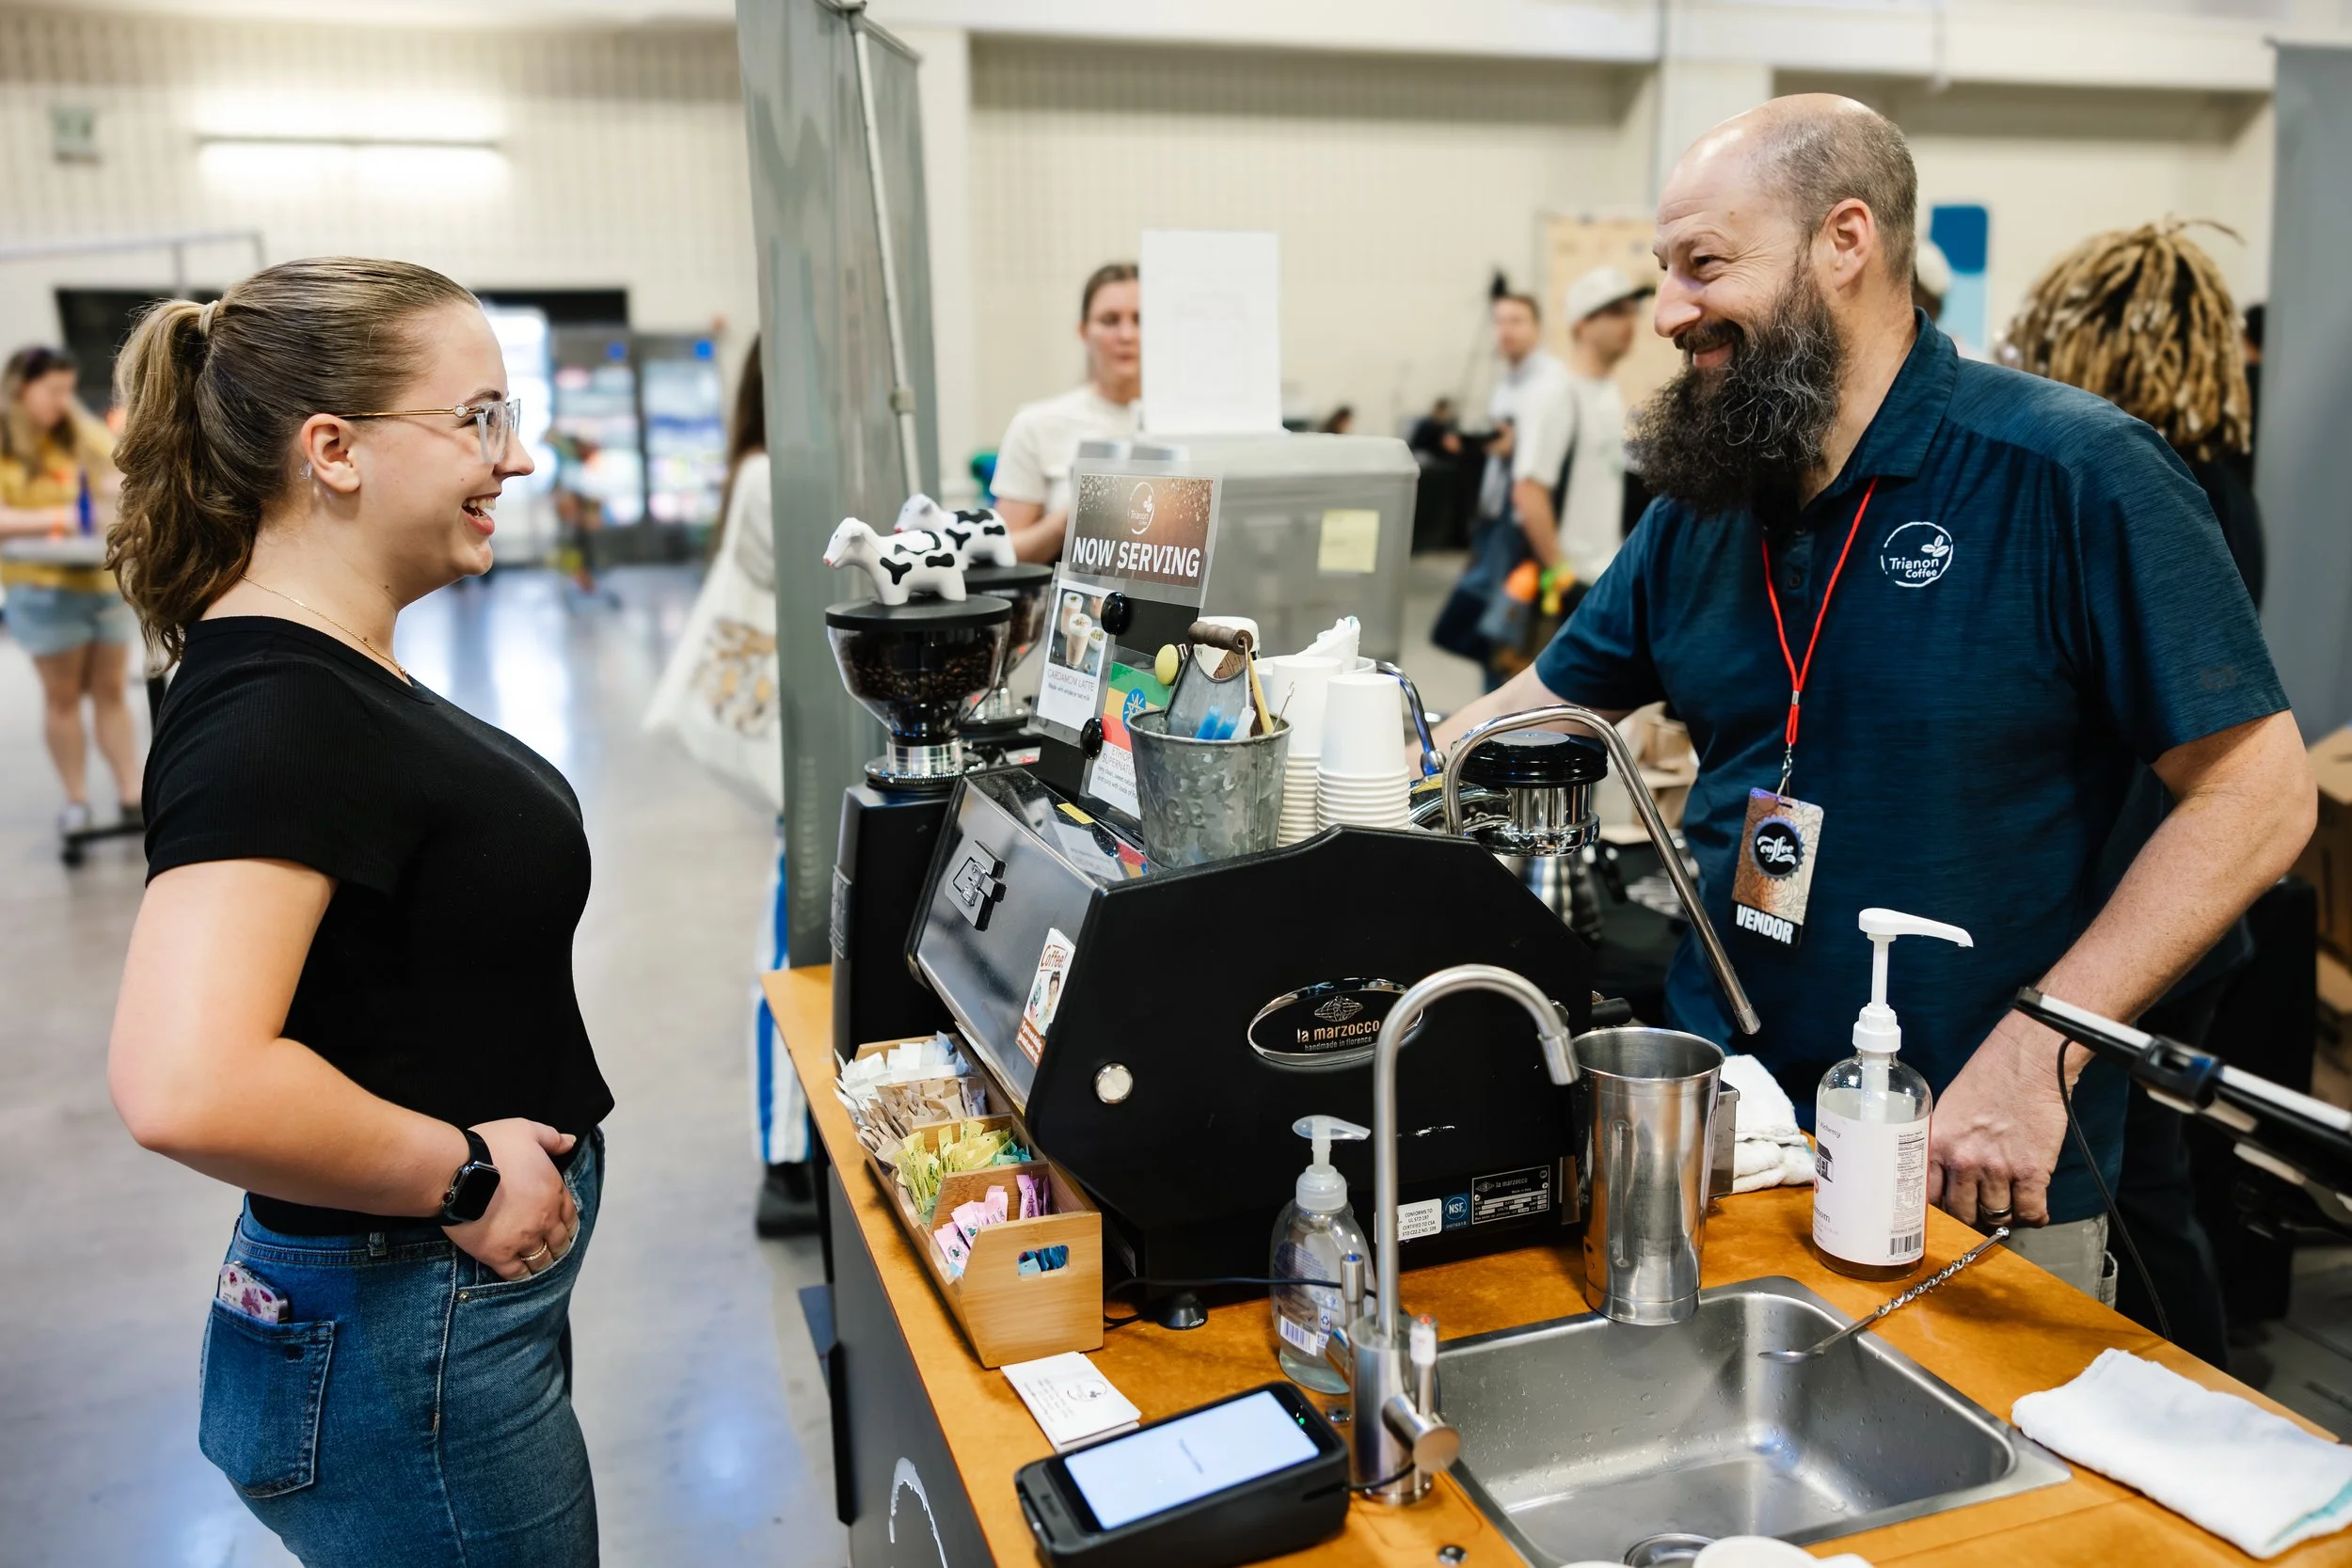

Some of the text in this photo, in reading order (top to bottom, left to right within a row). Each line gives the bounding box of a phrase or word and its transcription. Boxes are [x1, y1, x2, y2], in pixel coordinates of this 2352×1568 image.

[1072, 536, 1201, 578] NOW SERVING
[1888, 556, 1939, 570] Trianon
[1905, 568, 1938, 578] Coffee
[1047, 668, 1095, 692] CARDAMOM LATTE
[1111, 746, 1133, 761] ETHIOP
[1756, 835, 1796, 865] coffee
[1735, 903, 1794, 944] VENDOR
[1041, 944, 1069, 969] Coffee!
[1296, 1020, 1380, 1043] la marzocco
[1304, 1035, 1373, 1052] handmade in florence
[1495, 1177, 1529, 1189] la marzocco
[1449, 1202, 1464, 1214] NSF
